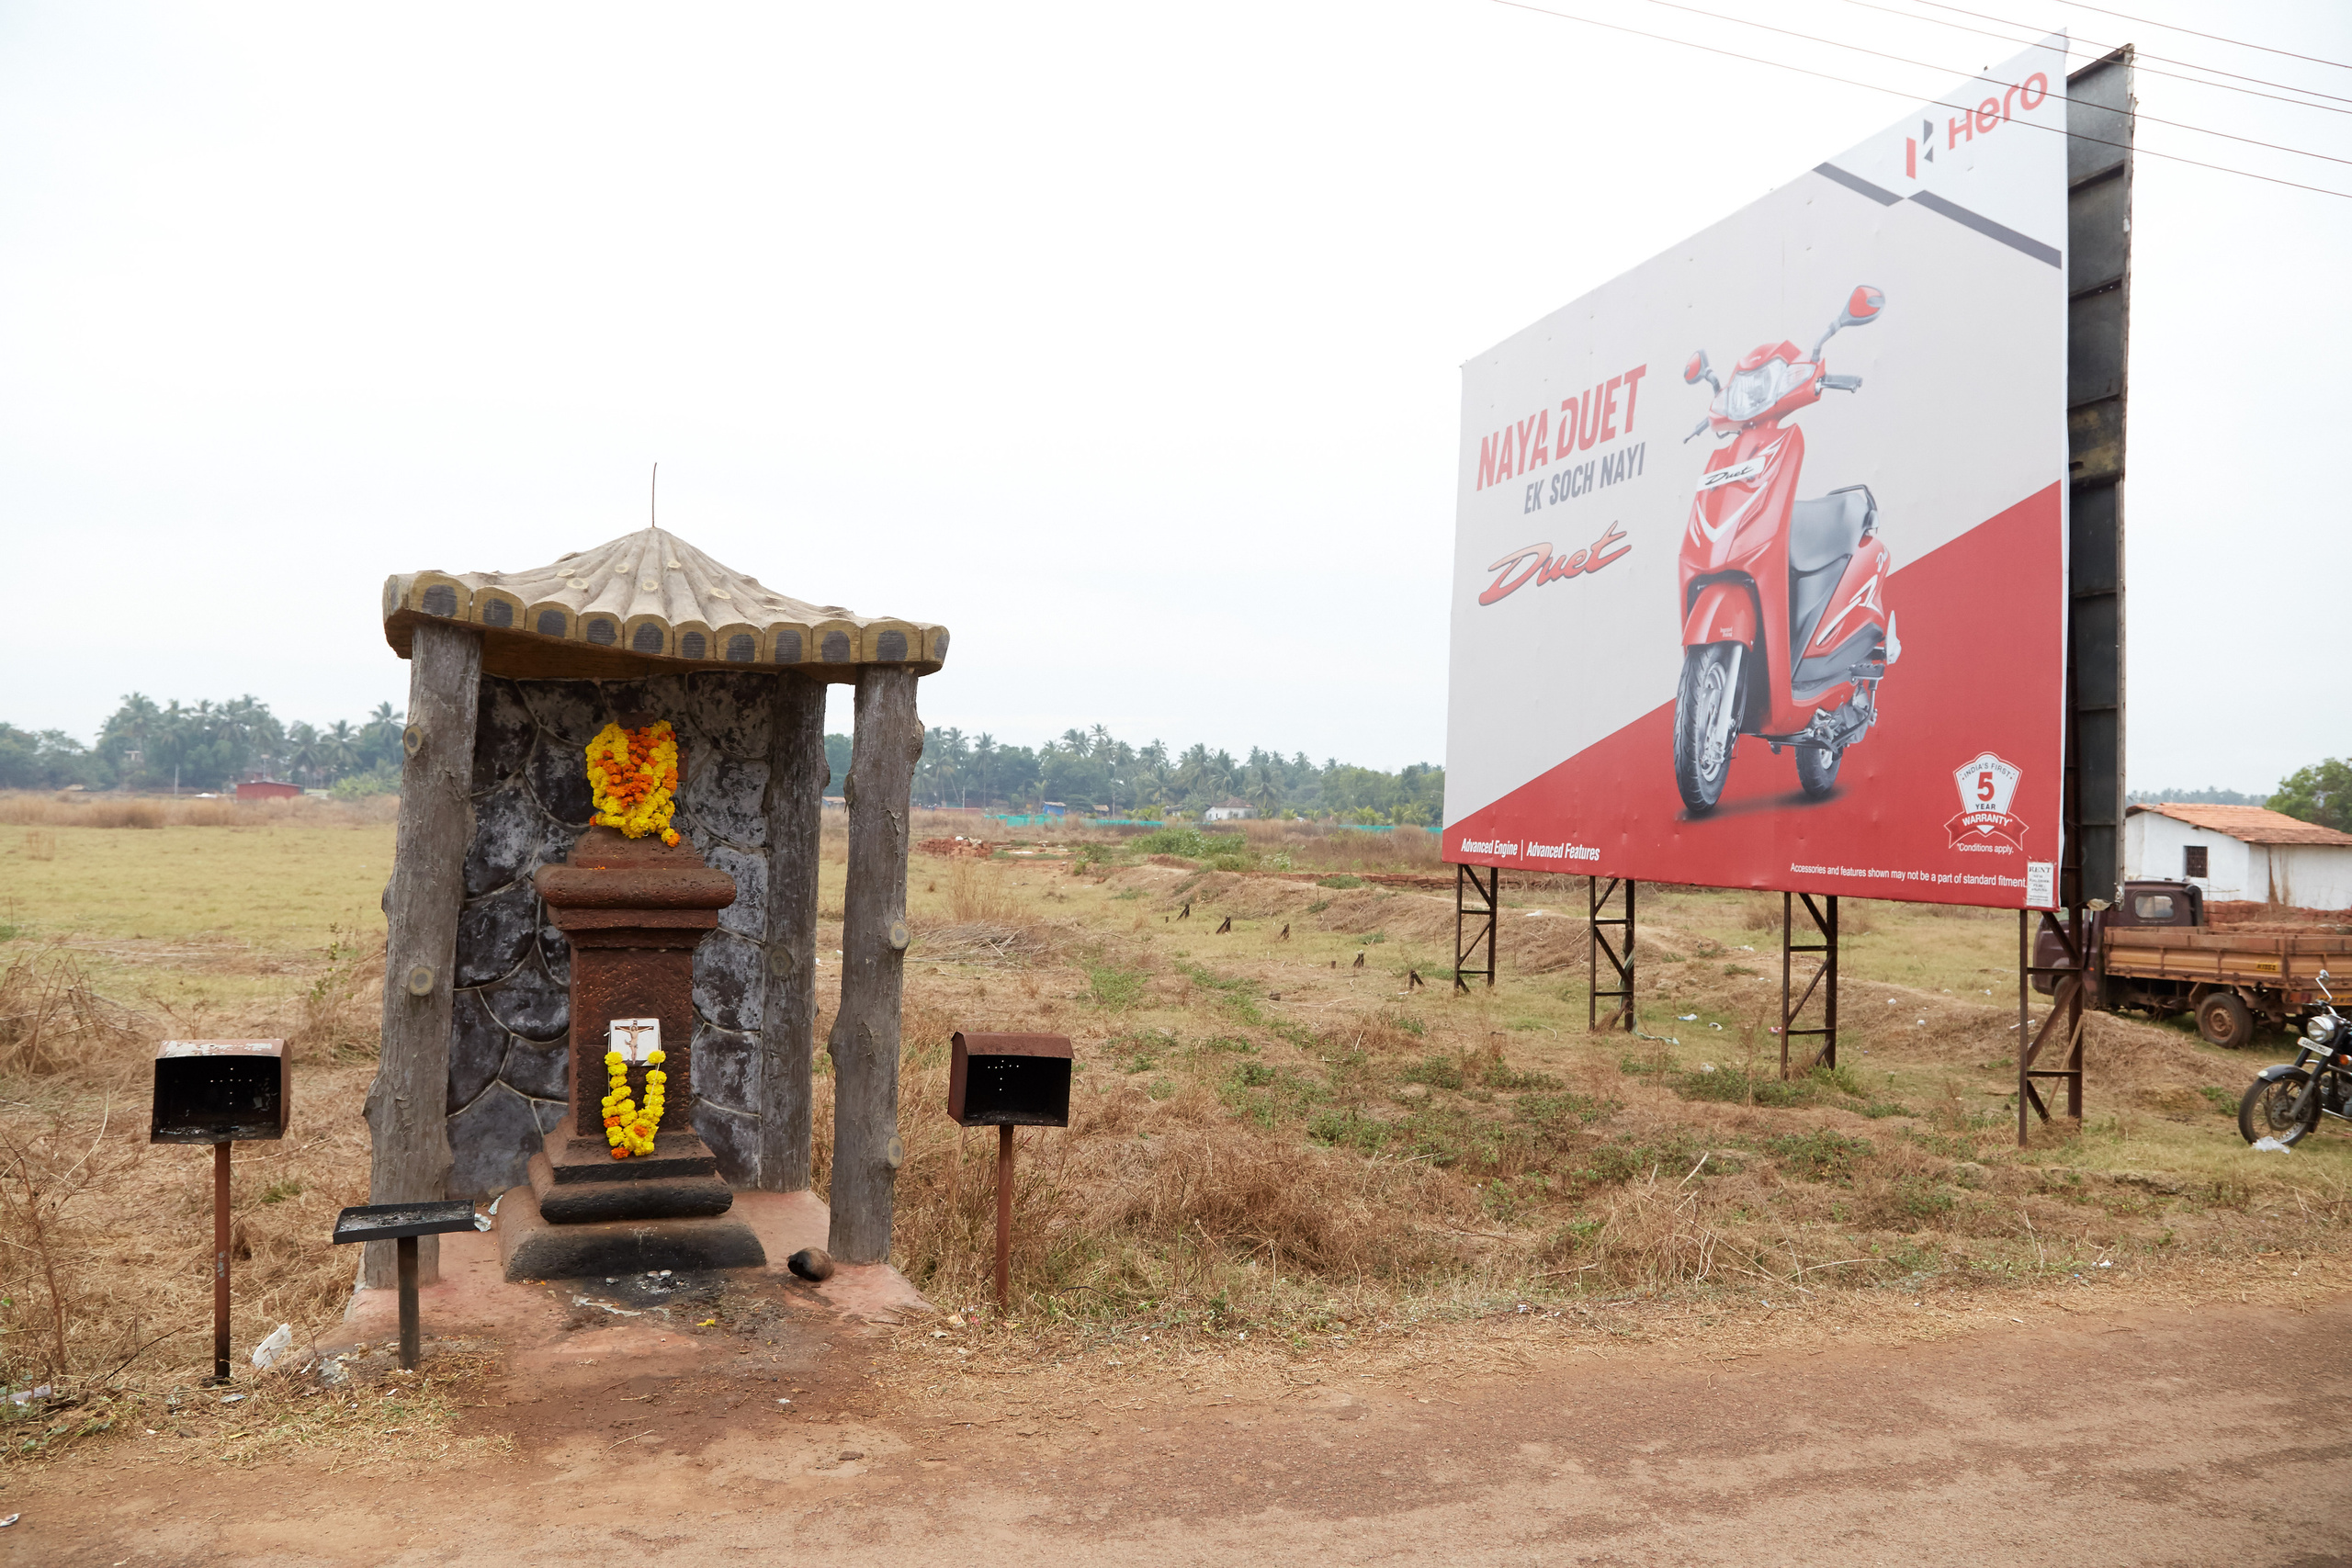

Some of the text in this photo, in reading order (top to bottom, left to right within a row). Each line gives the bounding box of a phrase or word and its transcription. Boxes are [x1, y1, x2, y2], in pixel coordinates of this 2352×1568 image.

[1949, 72, 2048, 151] Hero
[1476, 363, 1647, 491] NAYA DUET
[1523, 442, 1645, 514] EK SOCH NAYI
[1704, 466, 1754, 486] Duet
[1478, 520, 1632, 606] Duet
[1963, 762, 2011, 778] INDIA'S FIRST
[1977, 772, 1995, 802] 5
[1461, 838, 1600, 862] Advanced Engine Advanced Features
[1994, 844, 2014, 855] apply.
[1790, 863, 2027, 888] Accessories and features shown may not be a part of standard fitment.
